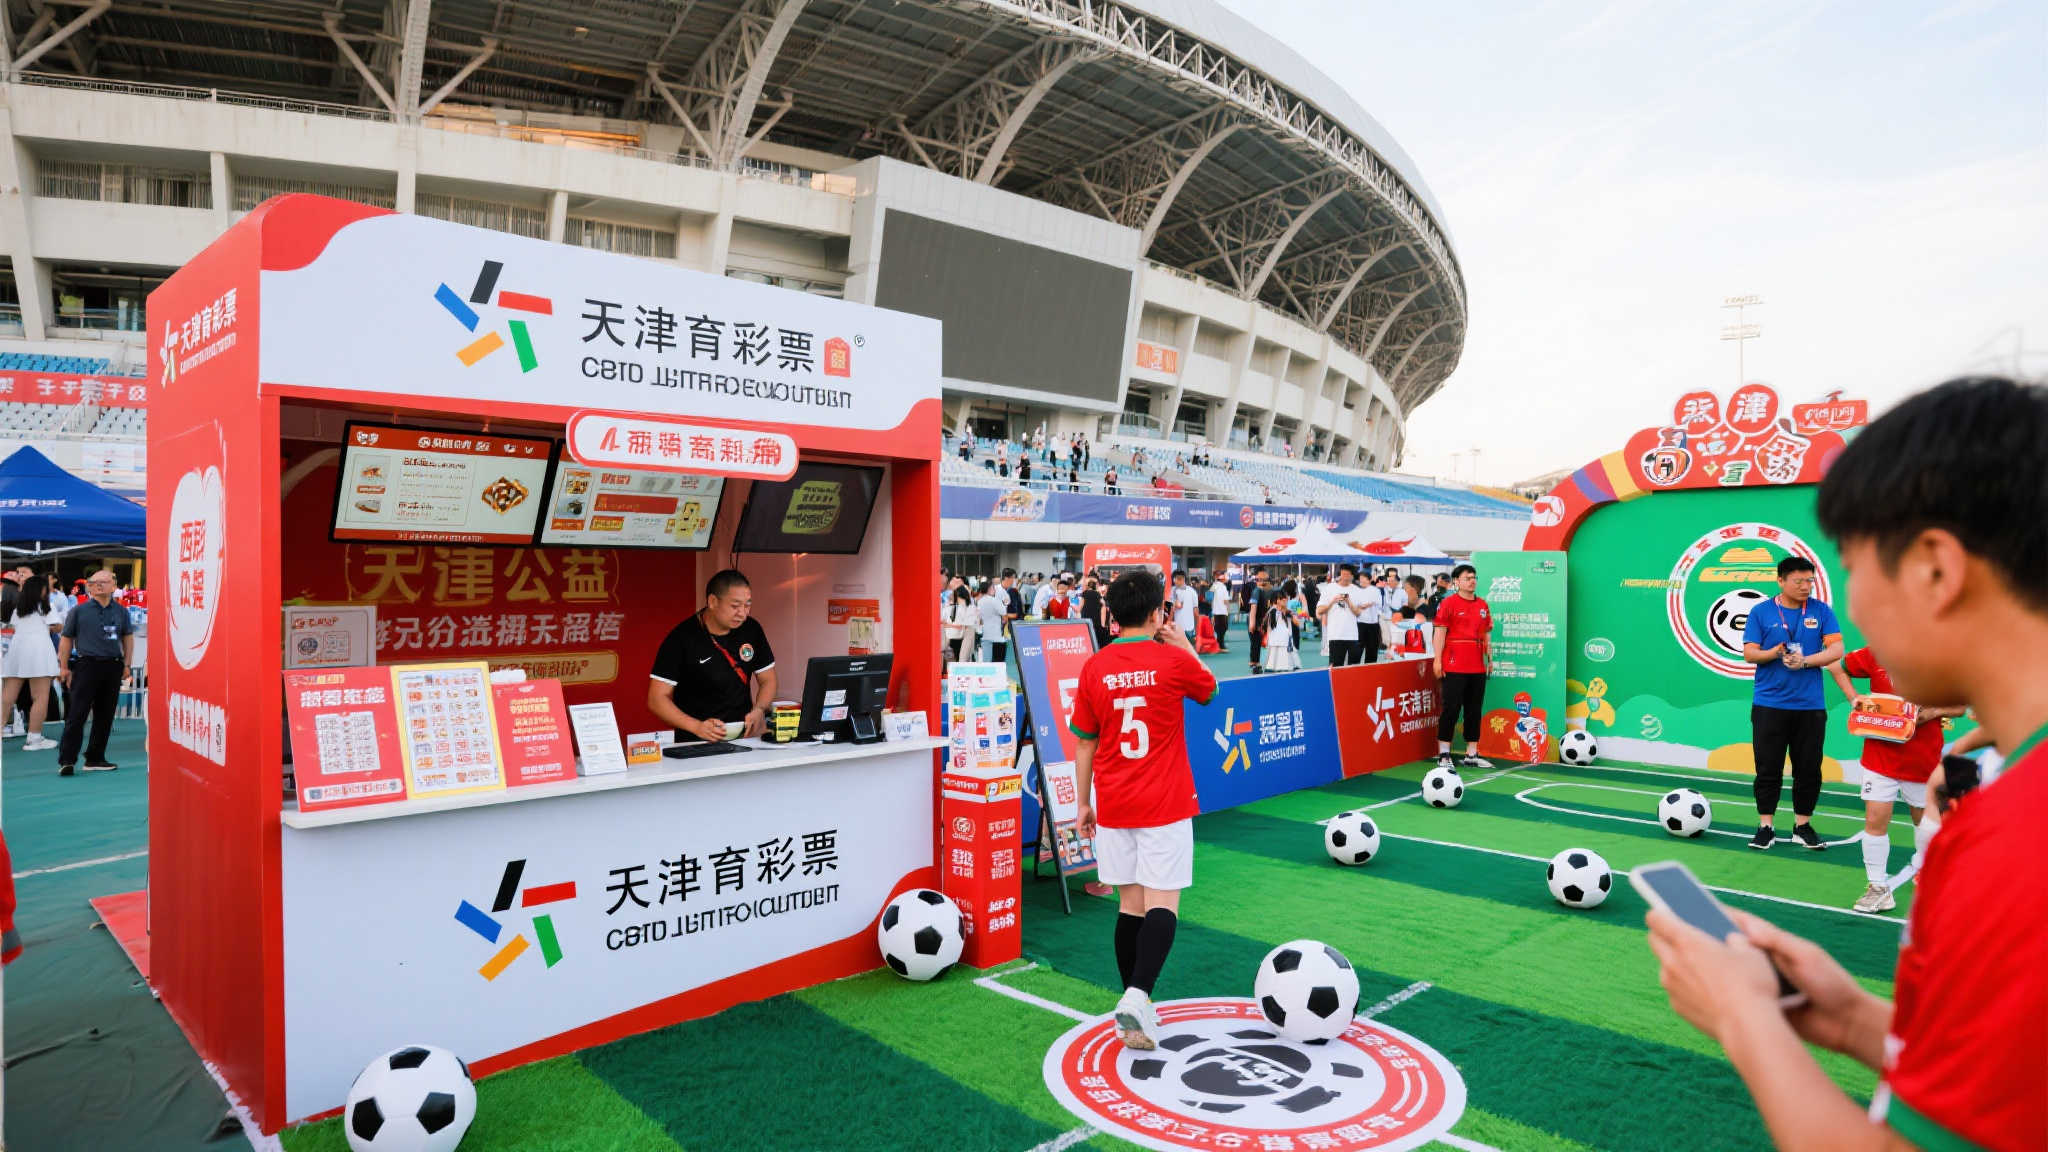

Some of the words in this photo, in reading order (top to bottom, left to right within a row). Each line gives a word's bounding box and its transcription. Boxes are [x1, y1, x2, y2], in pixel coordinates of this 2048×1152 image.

[581, 298, 815, 374] 天津育彩票
[1113, 696, 1149, 760] 5
[605, 829, 840, 916] 天津育彩票
